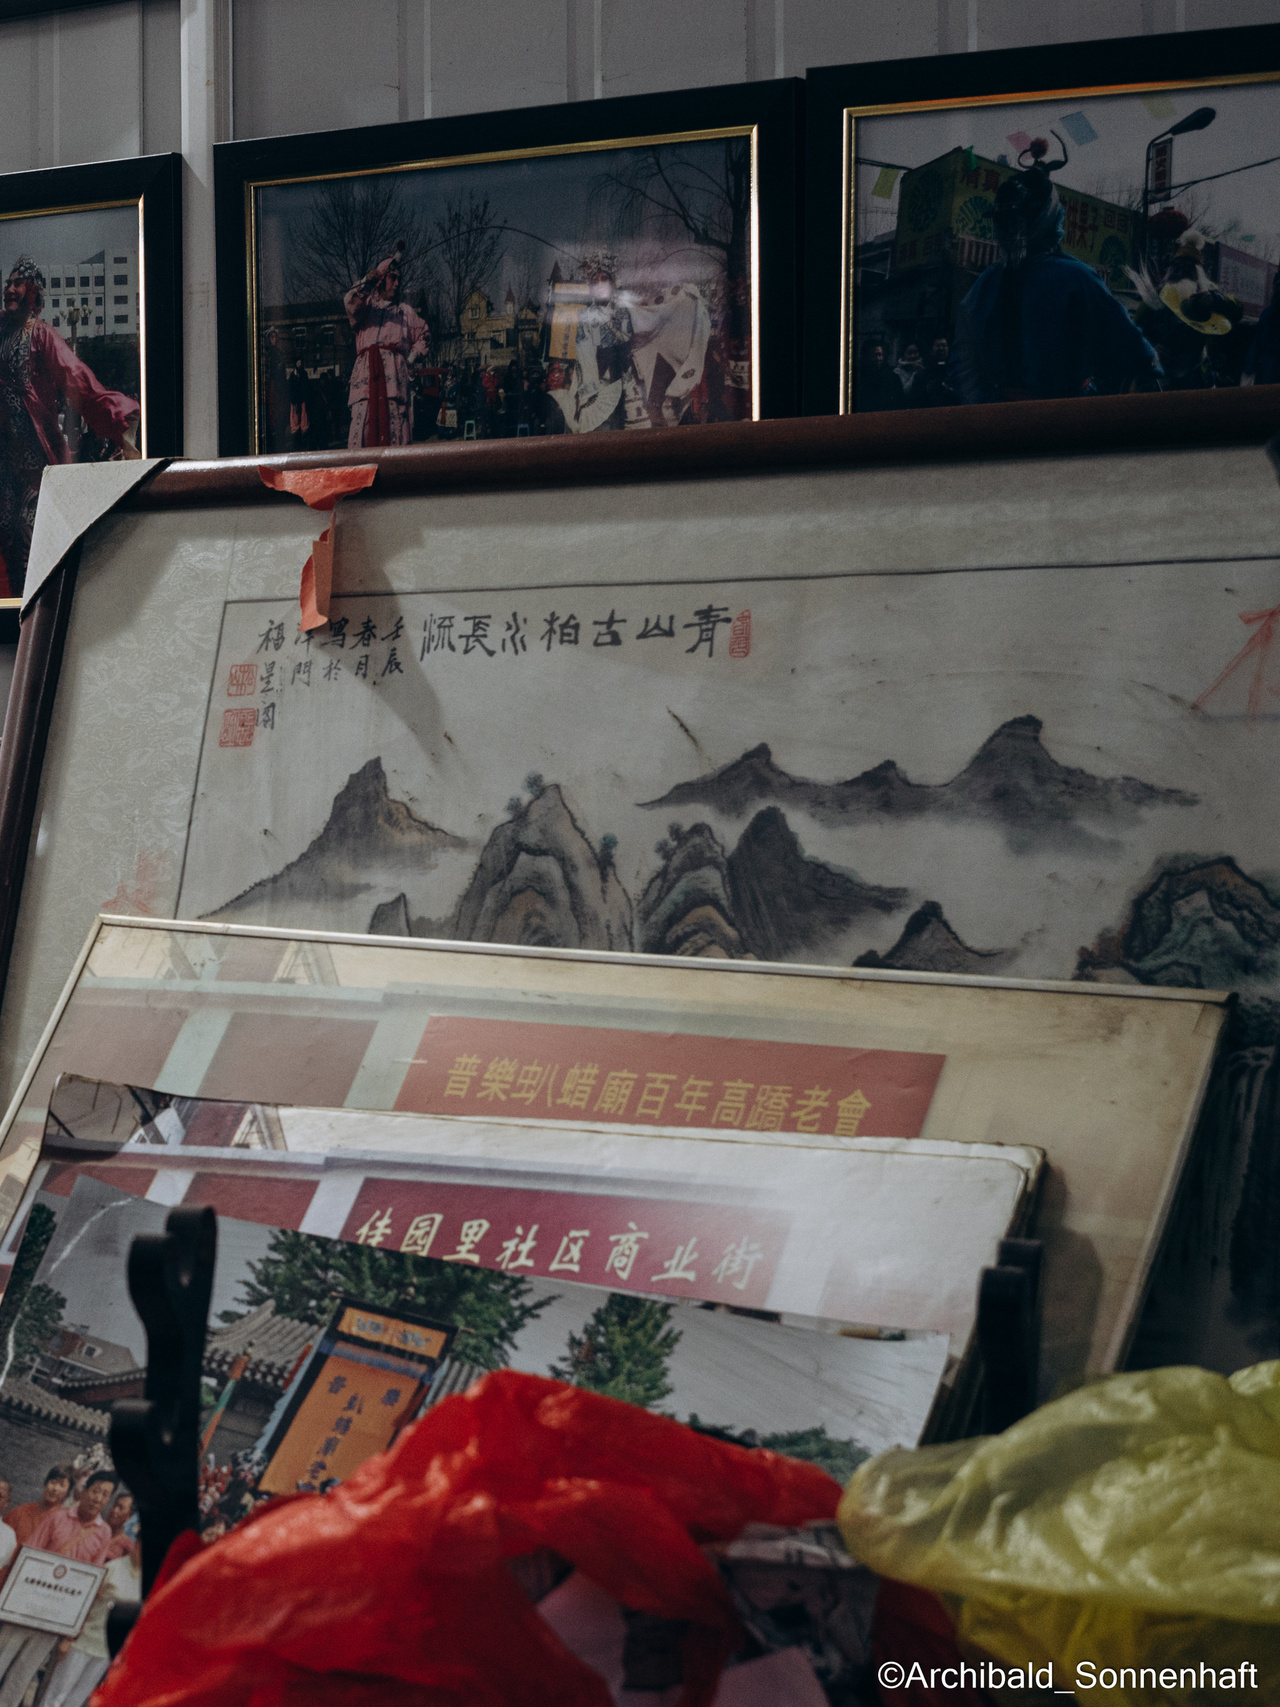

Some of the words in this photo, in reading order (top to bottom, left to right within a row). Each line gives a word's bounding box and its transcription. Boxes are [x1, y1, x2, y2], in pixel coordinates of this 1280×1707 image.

[356, 1207, 766, 1291] 佳园里社区商业街
